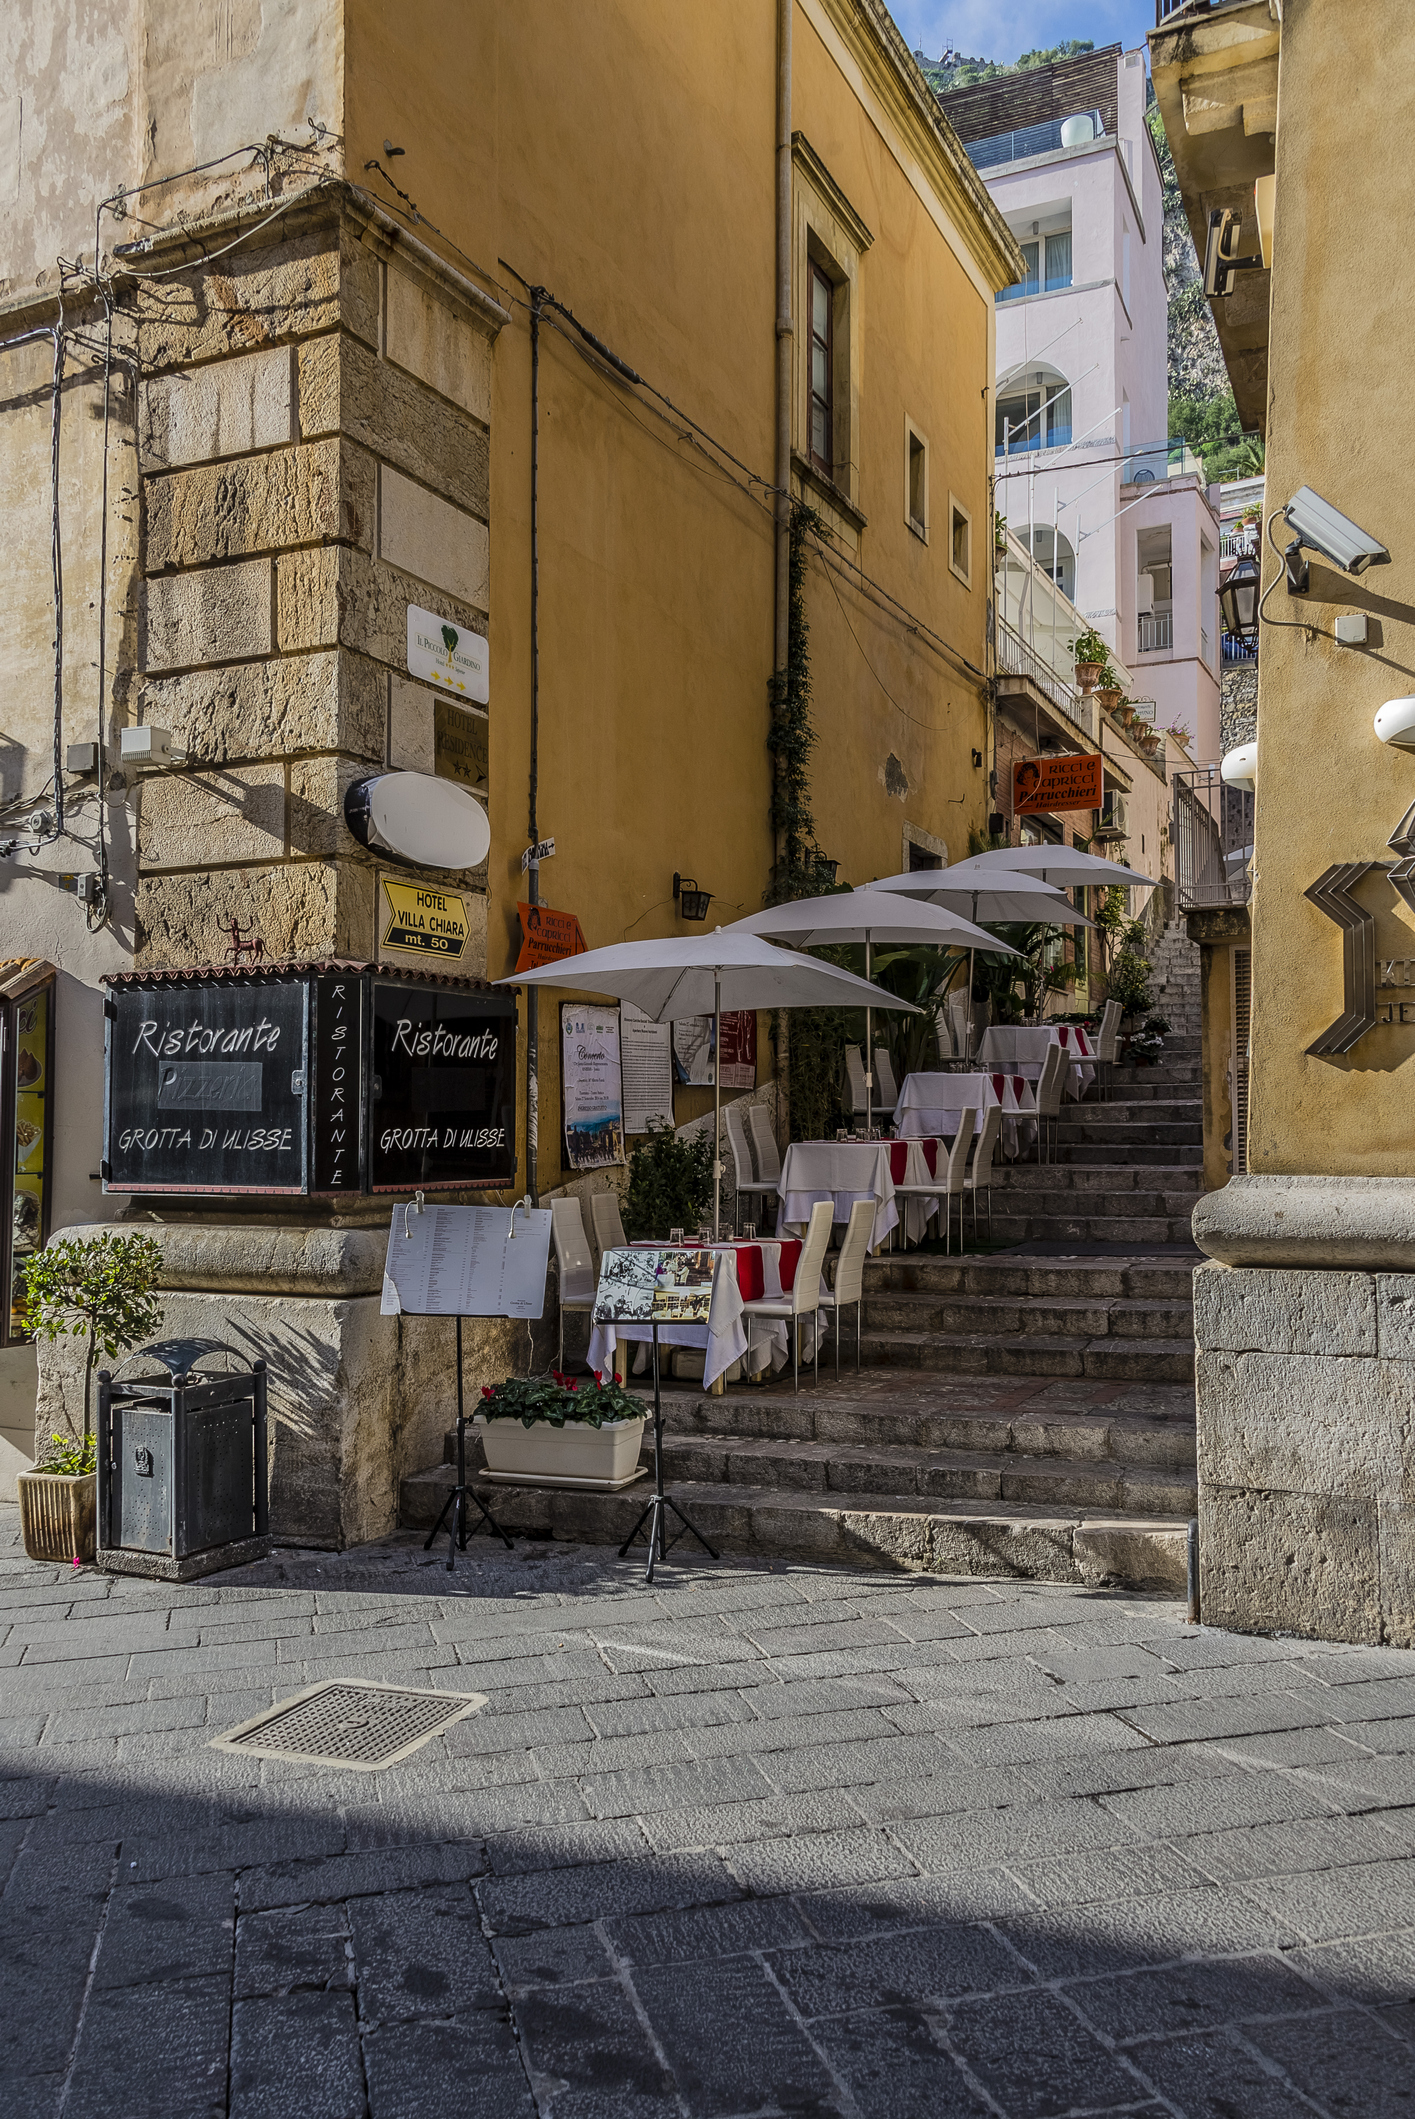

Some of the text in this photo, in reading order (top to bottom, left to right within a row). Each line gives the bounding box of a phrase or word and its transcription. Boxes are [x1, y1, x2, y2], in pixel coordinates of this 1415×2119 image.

[424, 638, 448, 657] PICCOLO
[453, 652, 481, 671] GIARDINO
[447, 708, 477, 736] HOTEL
[437, 731, 488, 764] RESIDENCE
[1019, 785, 1097, 802] Parrucchieri
[1035, 799, 1080, 809] Hairdresser
[416, 891, 448, 912] HOTEL
[397, 909, 464, 937] VILLA CHIARA
[405, 934, 448, 950] mt. 50
[528, 937, 572, 956] Parrucchieri
[132, 1017, 281, 1057] Ristorante
[391, 1018, 498, 1060] Ristorante
[330, 985, 348, 1184] RISTORANTE
[118, 1128, 292, 1153] GROTTA DI ULISSE
[380, 1128, 505, 1154] GROTTA DI ULISSE
